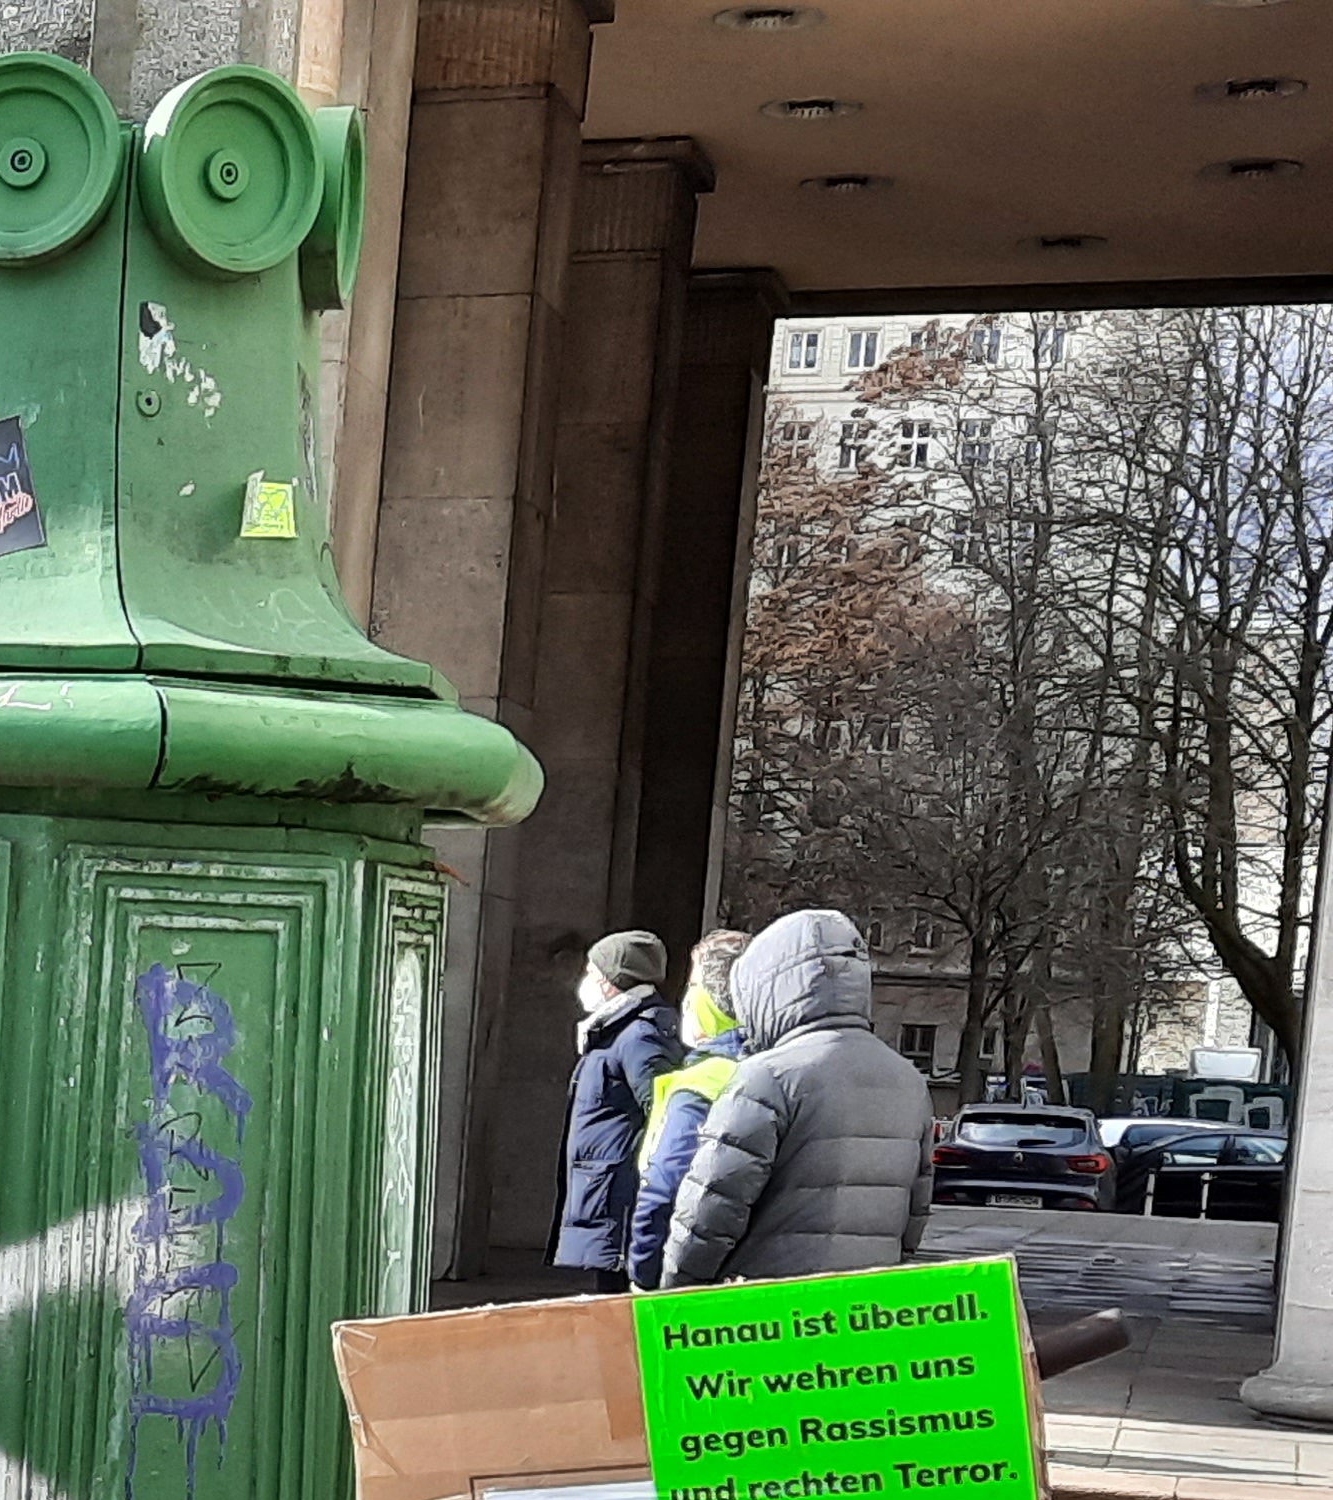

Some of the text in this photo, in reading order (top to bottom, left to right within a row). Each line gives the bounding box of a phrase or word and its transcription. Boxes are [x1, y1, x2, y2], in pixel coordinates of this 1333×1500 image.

[664, 1294, 988, 1350] Hanau ist überall.
[686, 1354, 975, 1400] Wir wehren uns
[681, 1407, 995, 1460] gegen Rassismus
[748, 1471, 882, 1500] rechten
[893, 1459, 1018, 1490] Terror.
